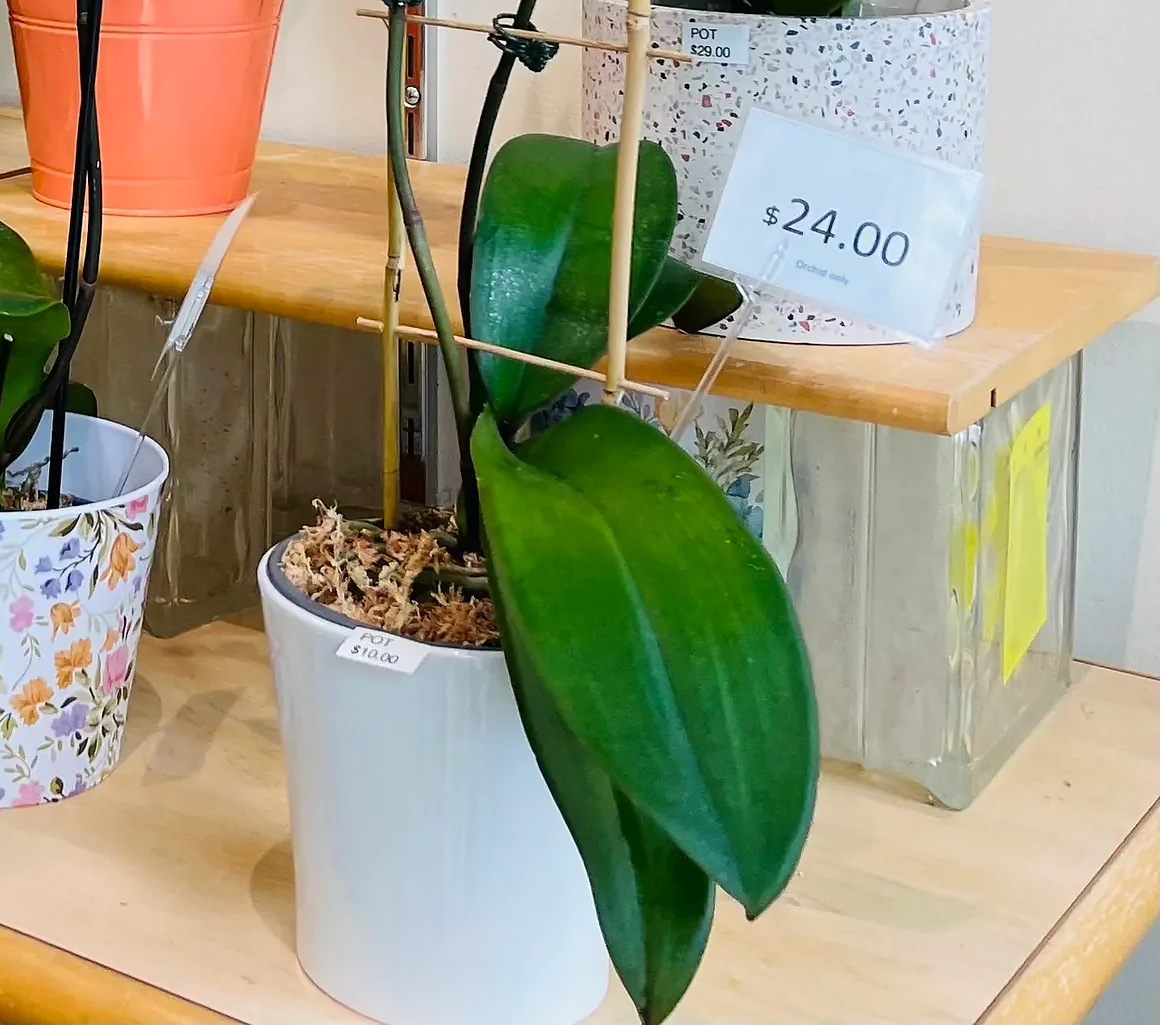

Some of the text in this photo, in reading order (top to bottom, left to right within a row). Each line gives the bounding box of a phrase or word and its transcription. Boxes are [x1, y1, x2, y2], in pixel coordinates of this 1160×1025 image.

[690, 27, 717, 40] POT
[690, 44, 731, 58] $29.00
[763, 198, 910, 267] $24.00
[796, 259, 850, 286] Orchid only
[360, 632, 394, 646] POT
[350, 644, 399, 664] $10.00
